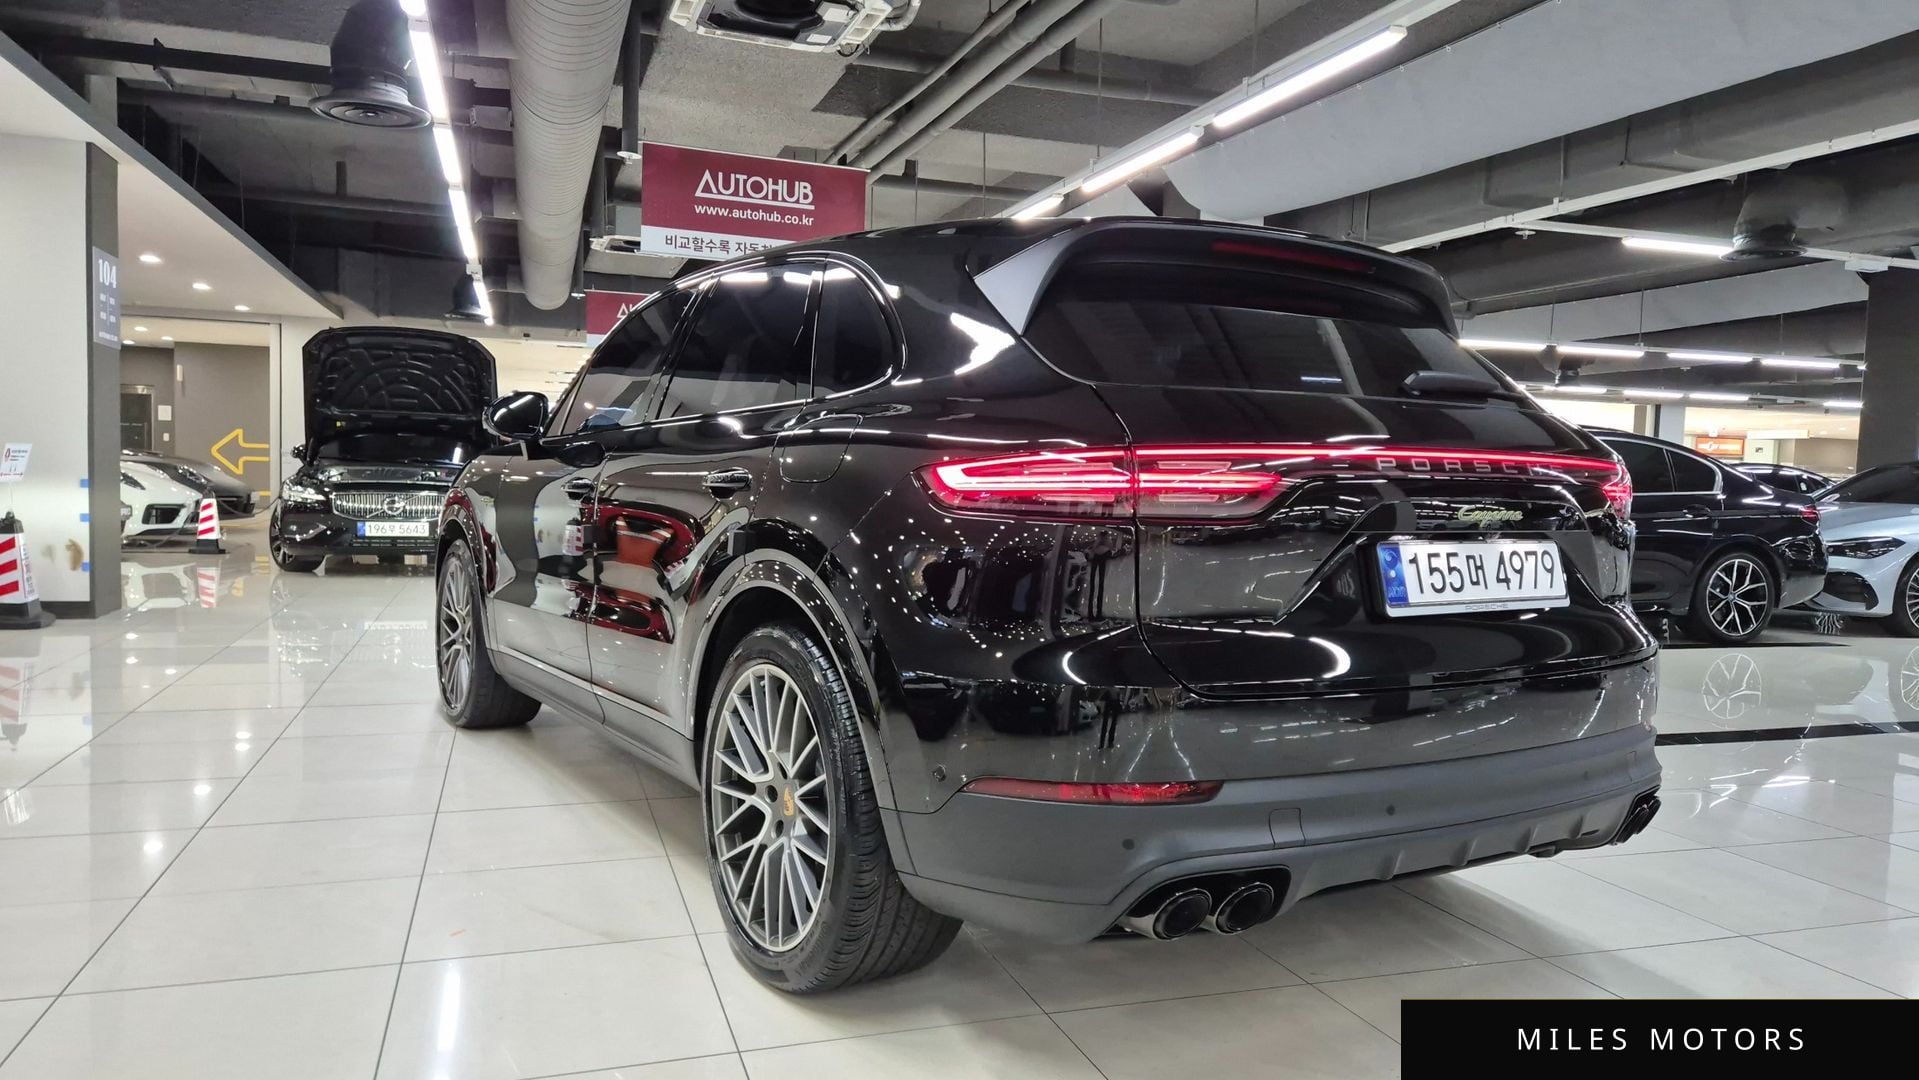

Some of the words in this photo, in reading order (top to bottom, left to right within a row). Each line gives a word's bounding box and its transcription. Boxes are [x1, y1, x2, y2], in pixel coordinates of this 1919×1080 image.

[695, 169, 815, 209] AUTOHUB
[694, 203, 815, 226] www.autohub.co.kr
[665, 234, 731, 255] 비교할수록
[98, 258, 117, 289] 104
[1376, 457, 1565, 477] PORSCHE
[1456, 505, 1524, 528] Cayenne
[1408, 552, 1489, 595] 155머
[1495, 550, 1555, 591] 4979
